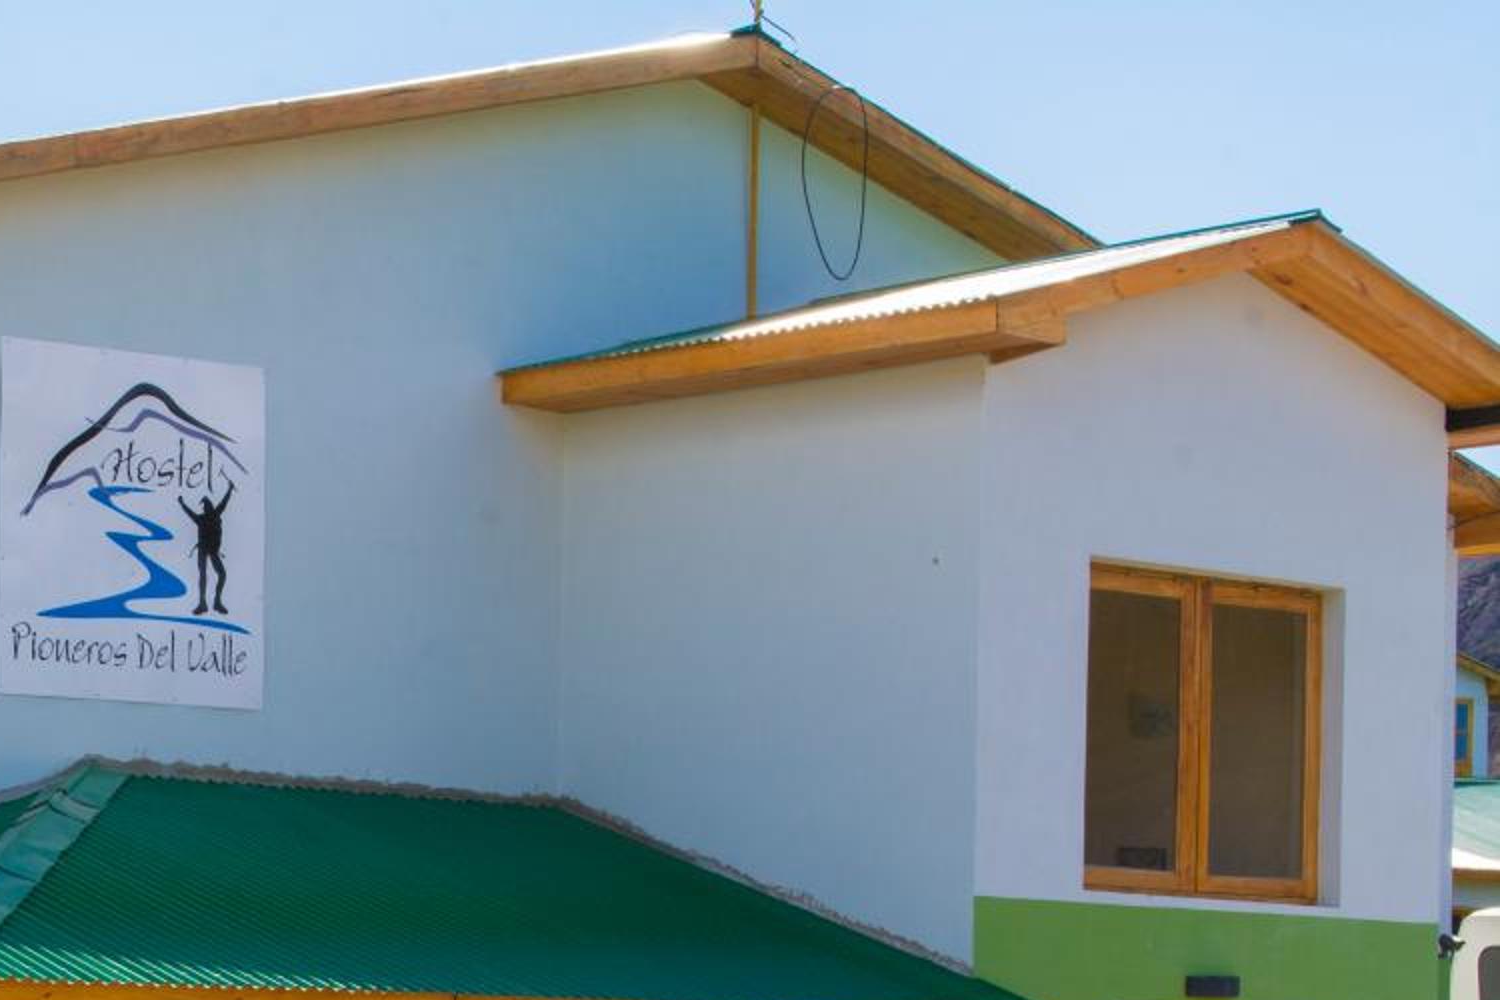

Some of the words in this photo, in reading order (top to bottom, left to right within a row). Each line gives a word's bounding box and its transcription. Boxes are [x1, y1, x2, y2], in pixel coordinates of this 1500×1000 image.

[102, 438, 213, 493] Hostel
[11, 621, 127, 667] Pioneros
[136, 630, 176, 673] Del
[188, 631, 248, 677] Valle
